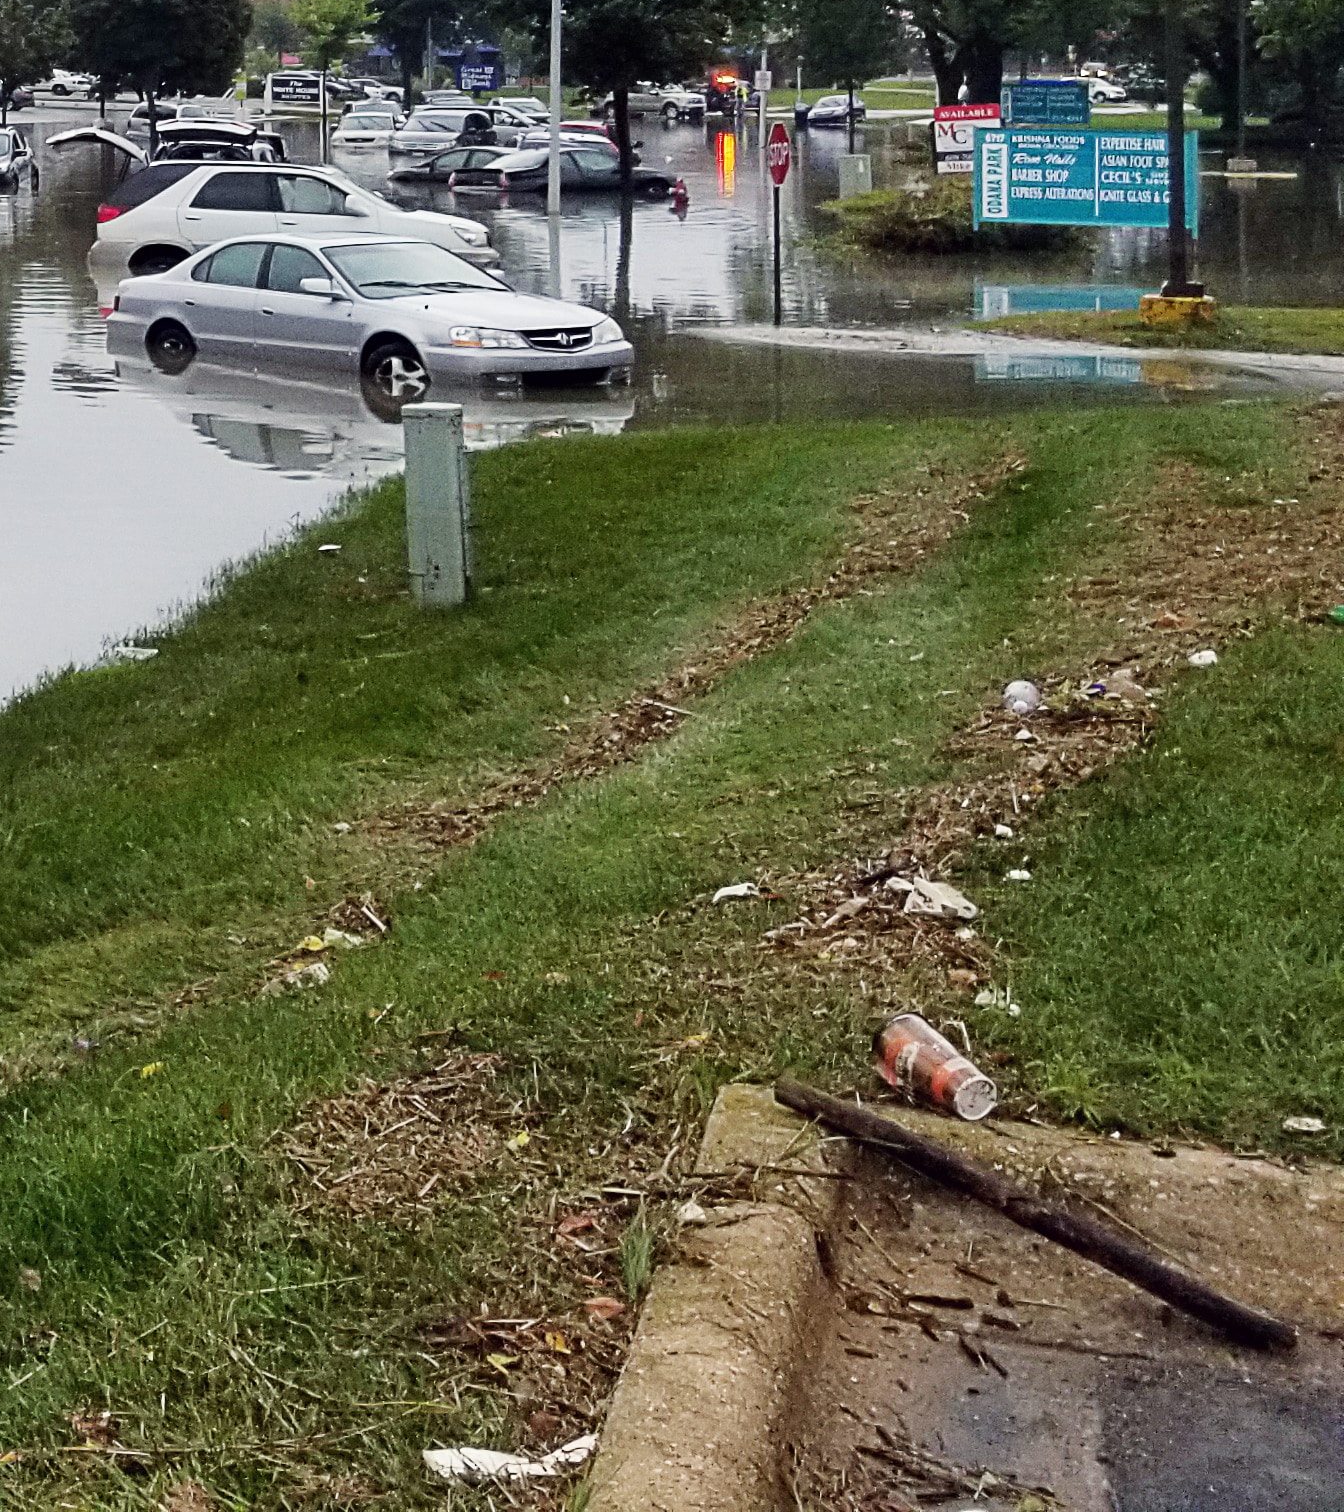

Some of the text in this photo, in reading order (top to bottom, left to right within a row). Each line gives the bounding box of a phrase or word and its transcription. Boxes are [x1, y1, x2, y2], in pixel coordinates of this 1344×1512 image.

[939, 108, 993, 118] AVAILABLE
[1012, 135, 1085, 145] KRISHNA FOODS
[1101, 137, 1166, 152] EXPERTISE HAIR
[769, 142, 789, 167] STOP
[1102, 155, 1128, 167] ASIAN
[1129, 155, 1155, 169] FOOT
[986, 147, 1003, 214] ODANA PARK
[1011, 169, 1070, 183] BARBER SHOP
[1101, 171, 1143, 185] CECIL'S
[1011, 187, 1095, 201] EXPRESS ALTERATIONS
[1126, 190, 1152, 203] GLASS
